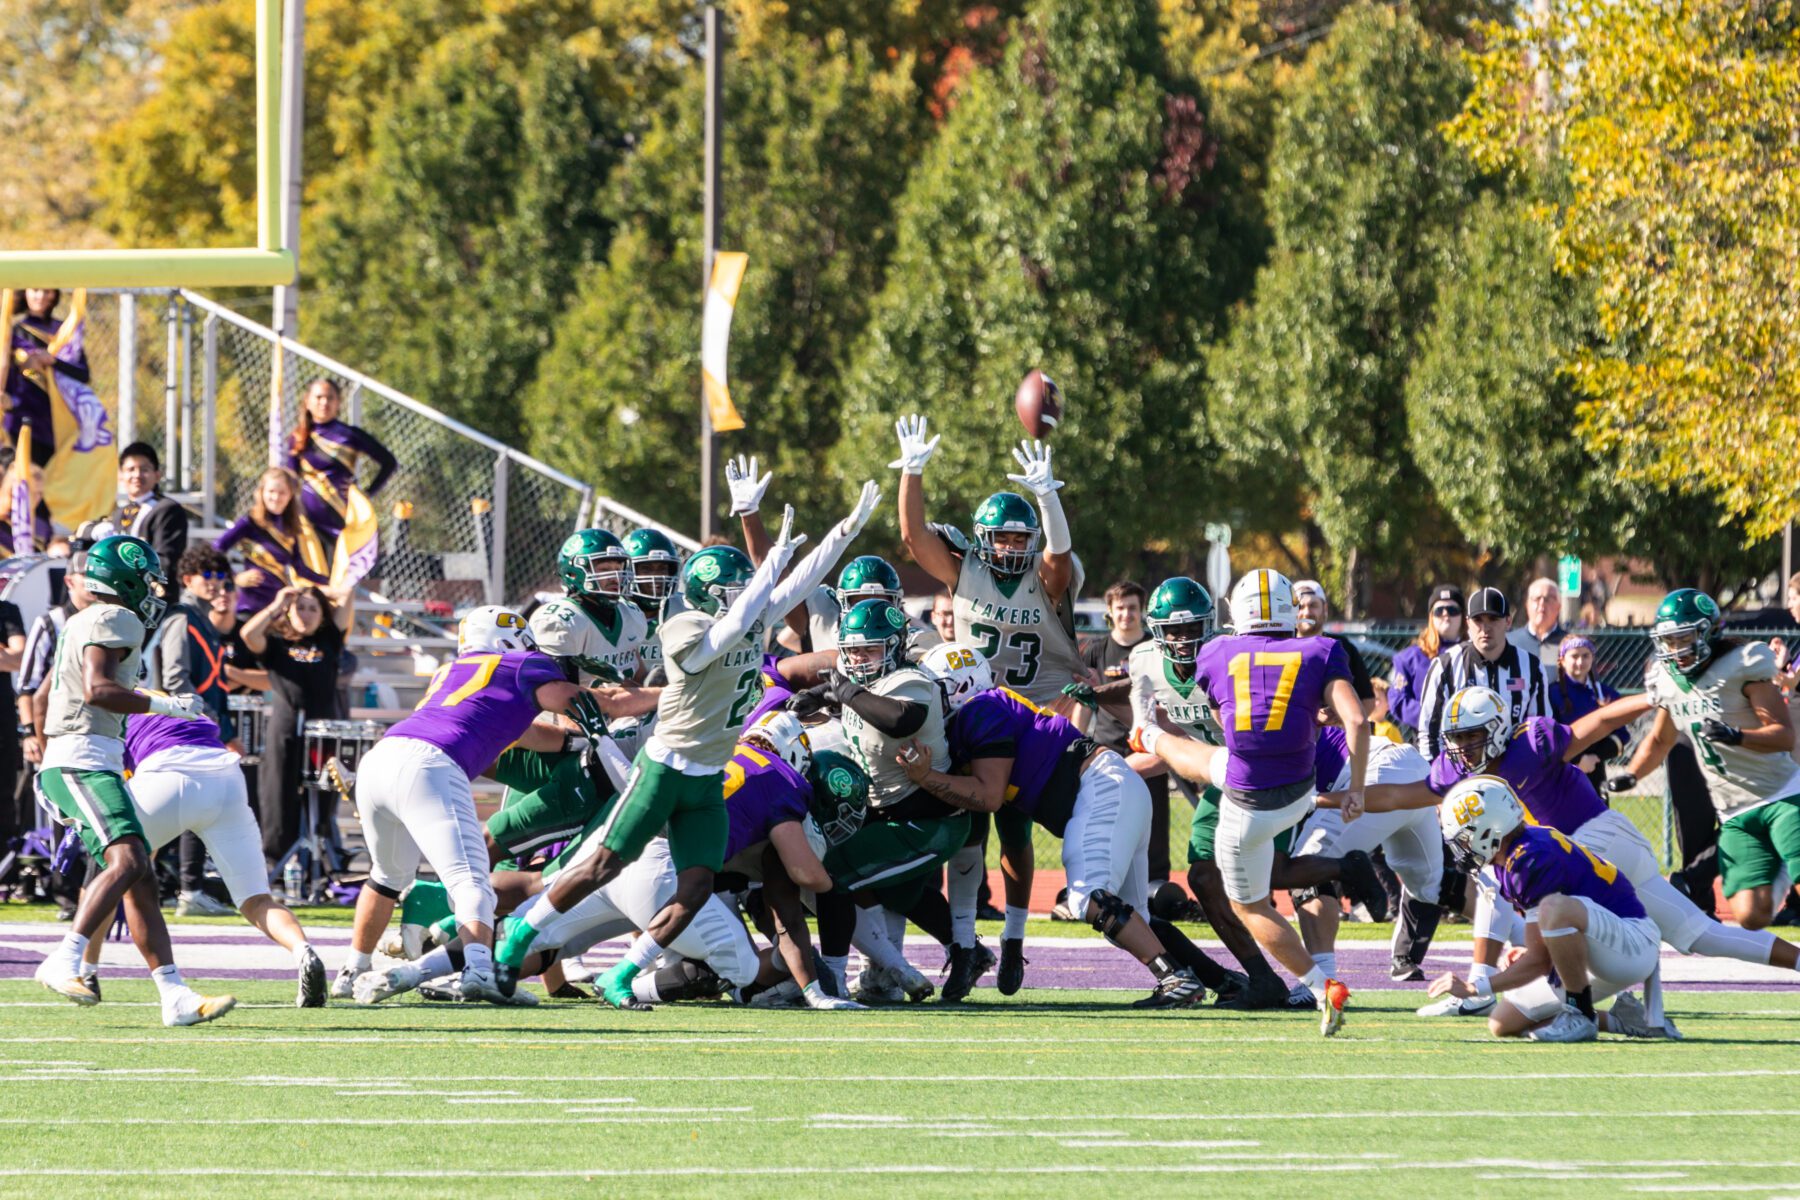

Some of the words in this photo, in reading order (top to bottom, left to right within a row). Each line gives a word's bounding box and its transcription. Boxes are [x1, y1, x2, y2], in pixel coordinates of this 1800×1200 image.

[545, 604, 575, 622] 93
[970, 598, 1041, 625] LAKERS
[970, 621, 1042, 688] 23
[1227, 651, 1302, 732] 17
[1512, 704, 1521, 718] S
[1453, 793, 1485, 826] 22
